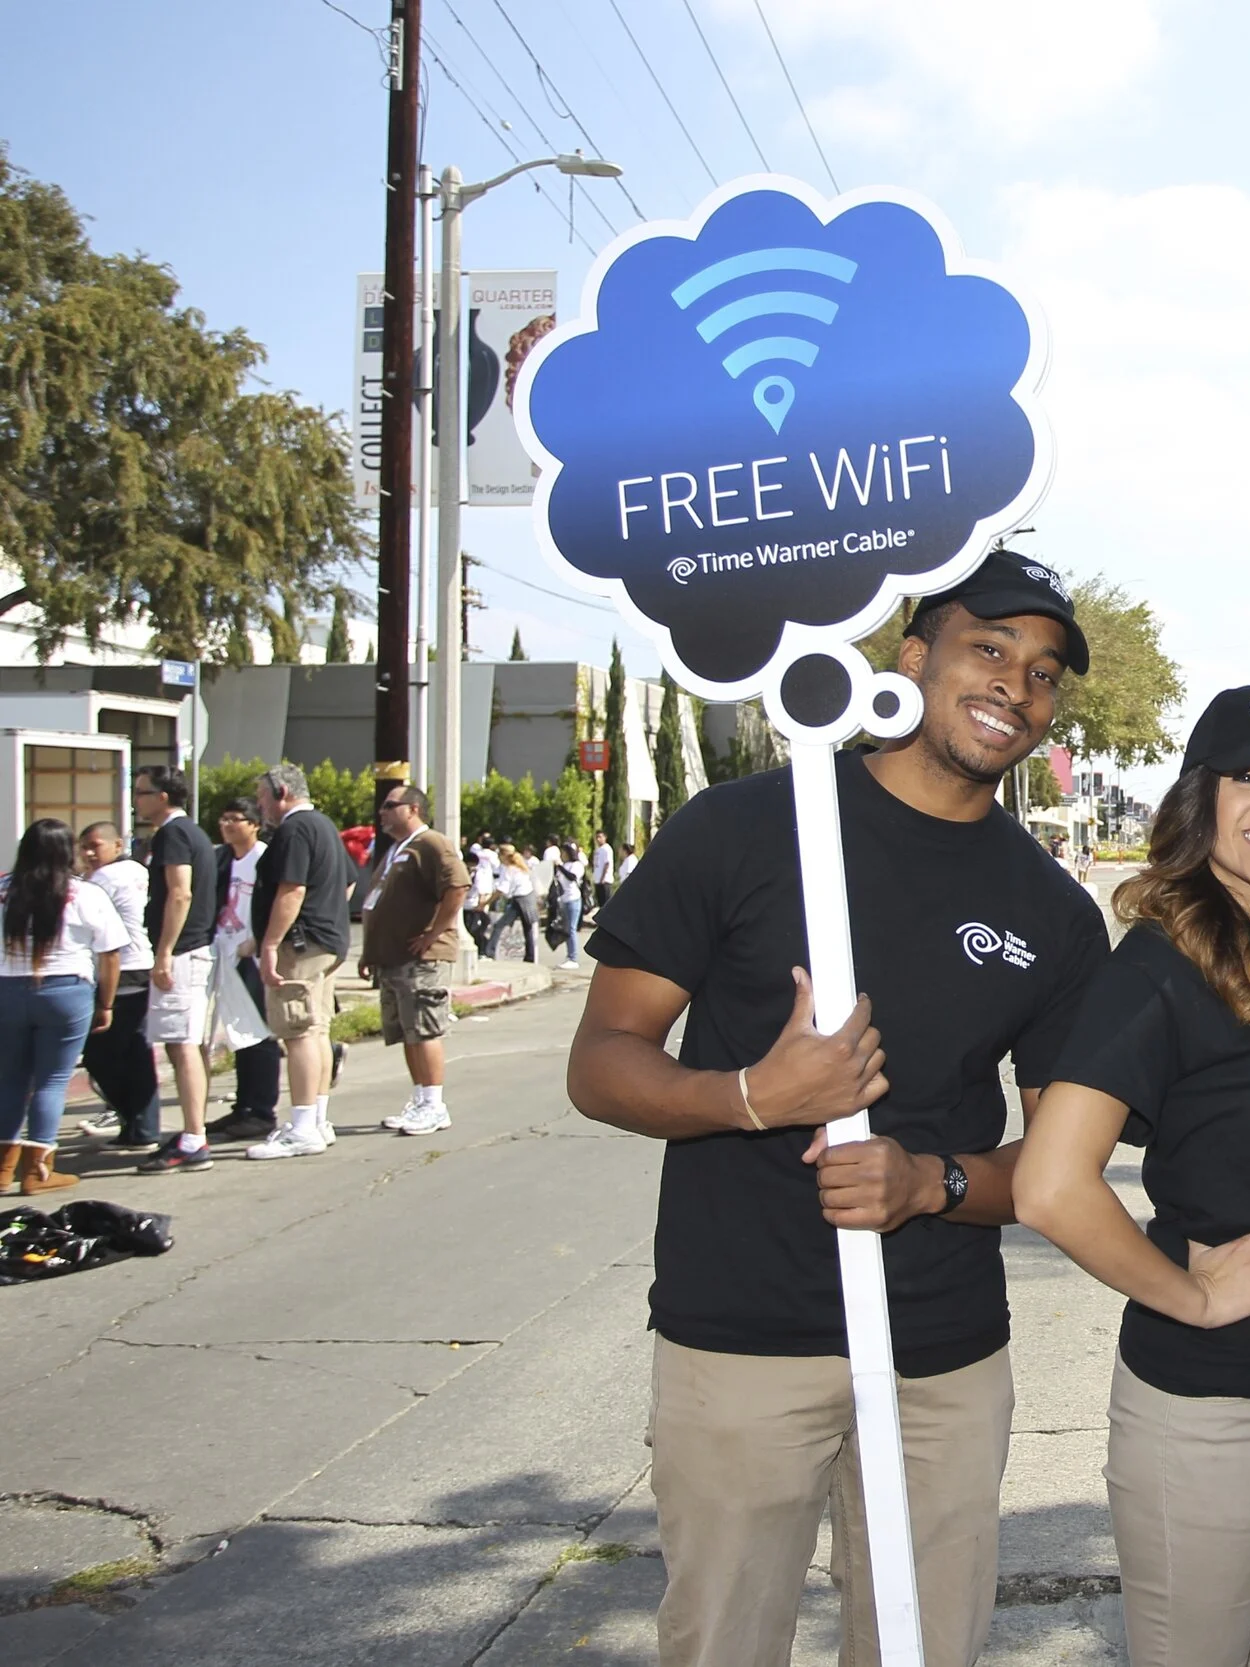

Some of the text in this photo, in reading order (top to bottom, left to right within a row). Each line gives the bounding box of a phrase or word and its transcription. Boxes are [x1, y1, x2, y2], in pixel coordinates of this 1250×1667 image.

[473, 290, 554, 303] QUARTER
[618, 434, 952, 540] FREE WiFi
[697, 551, 754, 574] Time
[756, 537, 840, 567] Warner
[1004, 930, 1027, 948] Time
[1003, 940, 1037, 962] Warner
